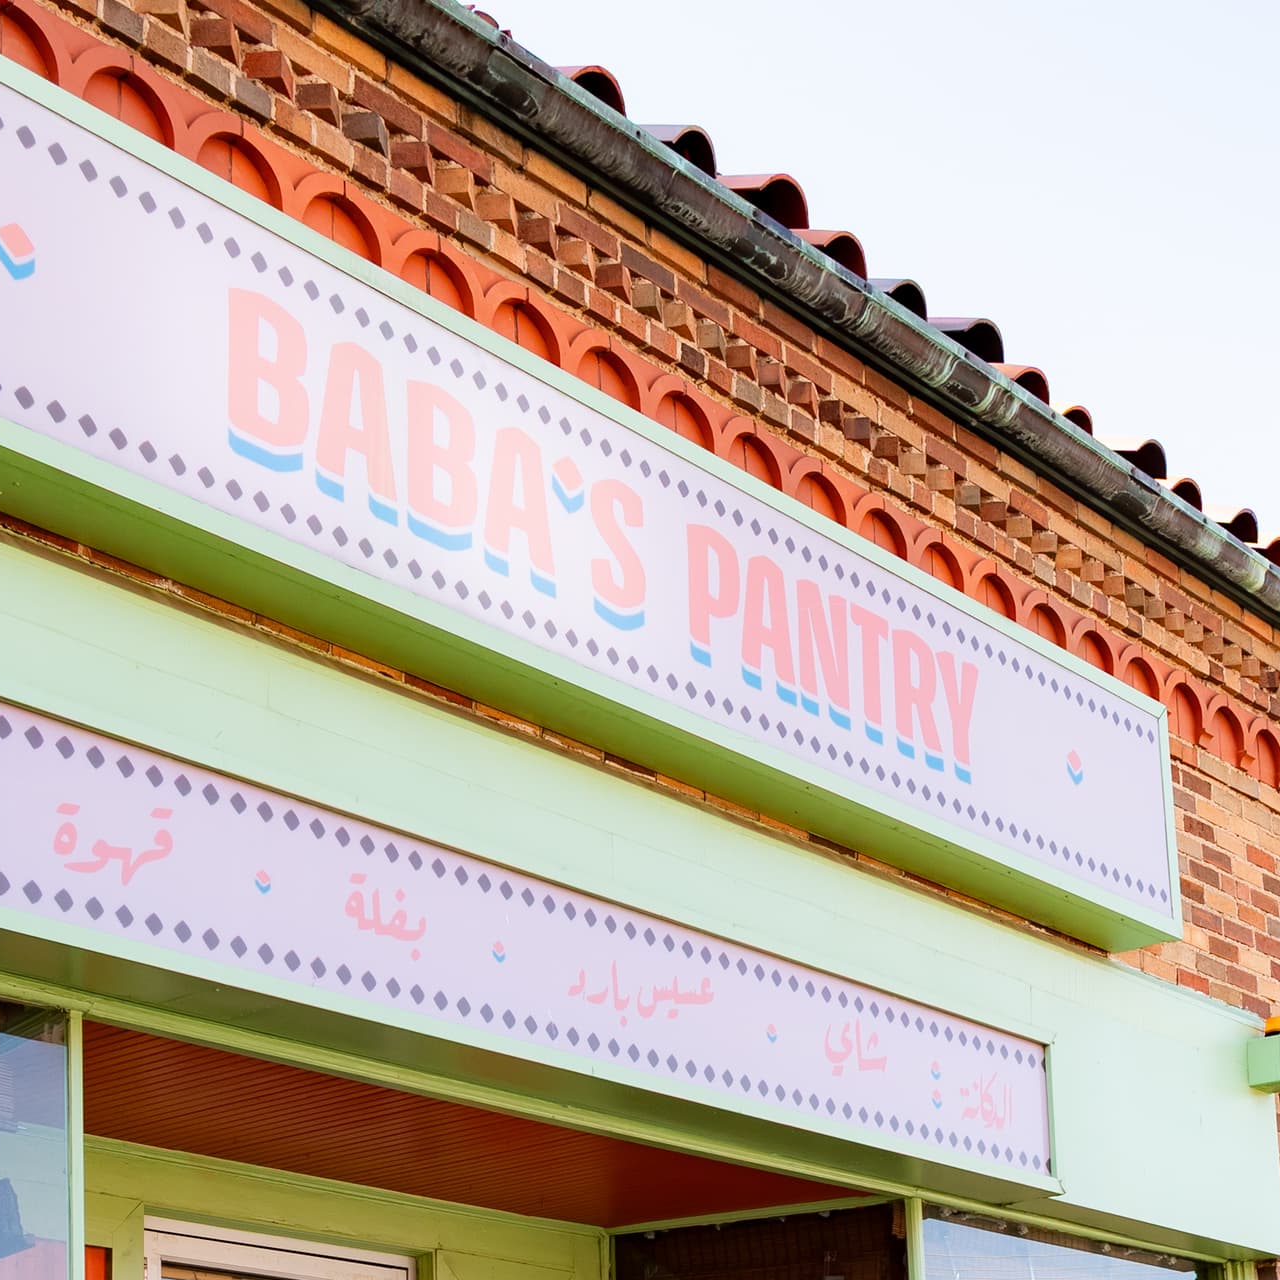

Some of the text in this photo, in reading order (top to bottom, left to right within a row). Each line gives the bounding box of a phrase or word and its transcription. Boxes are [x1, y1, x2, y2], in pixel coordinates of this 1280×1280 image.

[228, 287, 979, 785] BABA'S PANTRY
[53, 802, 175, 887] قهوة
